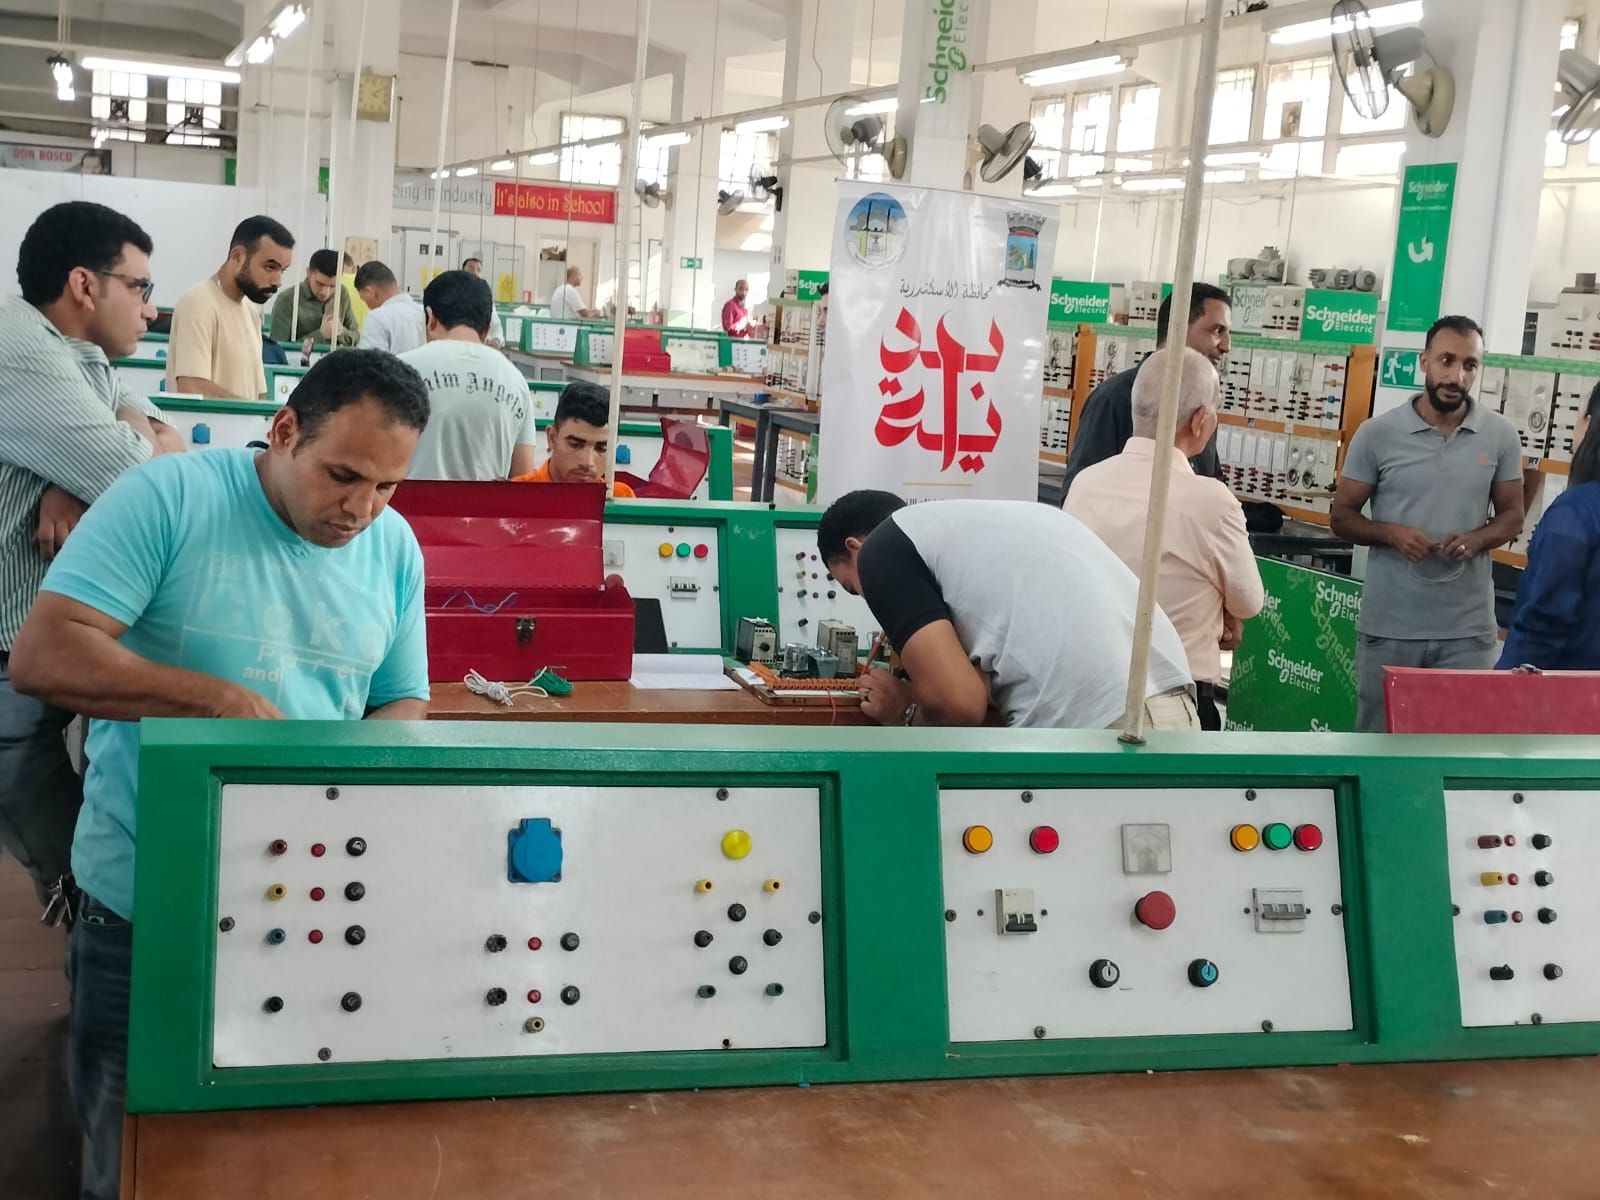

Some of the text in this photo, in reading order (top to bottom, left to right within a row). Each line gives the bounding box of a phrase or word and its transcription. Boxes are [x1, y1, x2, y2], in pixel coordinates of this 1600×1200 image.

[13, 148, 73, 163] DON BOSCO
[424, 182, 436, 201] in
[496, 187, 605, 216] It's also in School
[961, 281, 993, 300] محافظة
[1050, 292, 1109, 308] Schneider
[1074, 305, 1107, 315] Electric
[1306, 304, 1377, 325] Schneider
[1335, 321, 1374, 334] Electric
[424, 370, 459, 392] alm
[242, 664, 281, 684] and
[1267, 648, 1324, 683] Schneider
[1289, 674, 1321, 695] Electric
